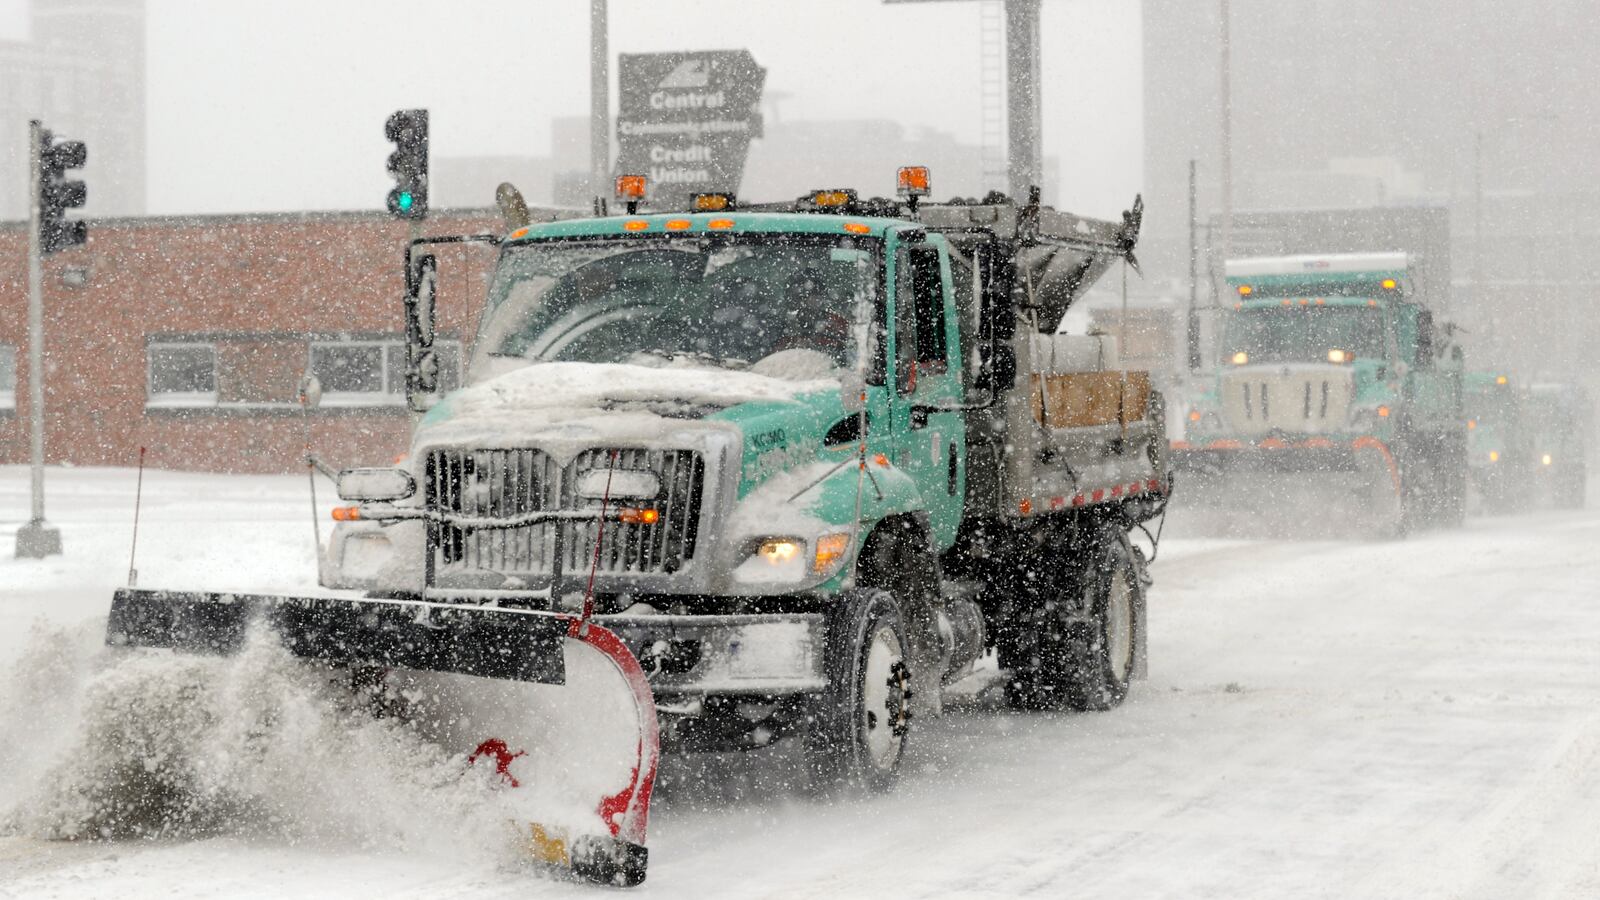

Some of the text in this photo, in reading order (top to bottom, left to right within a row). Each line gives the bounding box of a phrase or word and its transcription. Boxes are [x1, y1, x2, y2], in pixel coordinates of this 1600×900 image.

[651, 91, 725, 109] Central
[651, 145, 713, 162] Credit
[651, 167, 709, 184] Union
